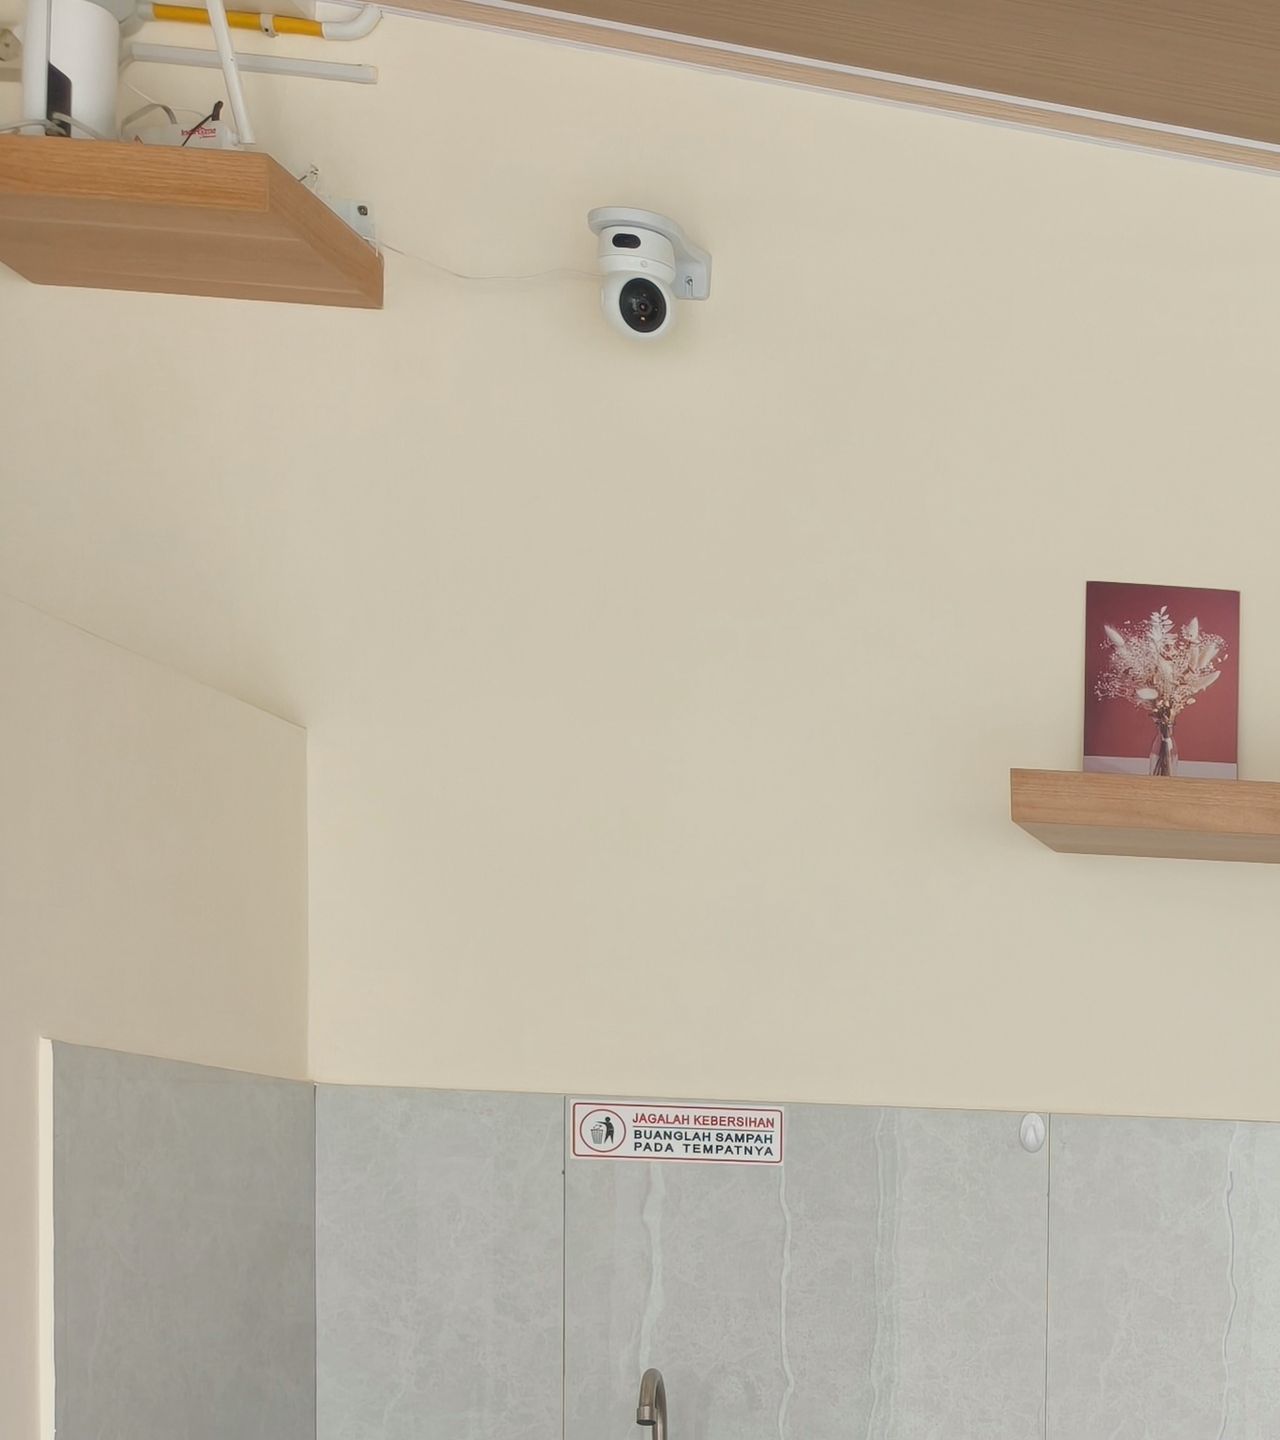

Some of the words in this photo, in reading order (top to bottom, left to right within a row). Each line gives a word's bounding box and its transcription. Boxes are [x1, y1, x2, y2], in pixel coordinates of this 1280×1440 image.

[632, 1112, 690, 1126] JAGALAH
[693, 1114, 775, 1128] KEBERSIHAN
[633, 1129, 712, 1142] BUANGLAH
[715, 1131, 773, 1144] SAMPAH
[633, 1142, 674, 1153] PADA
[682, 1143, 774, 1156] TEMPATNYA
